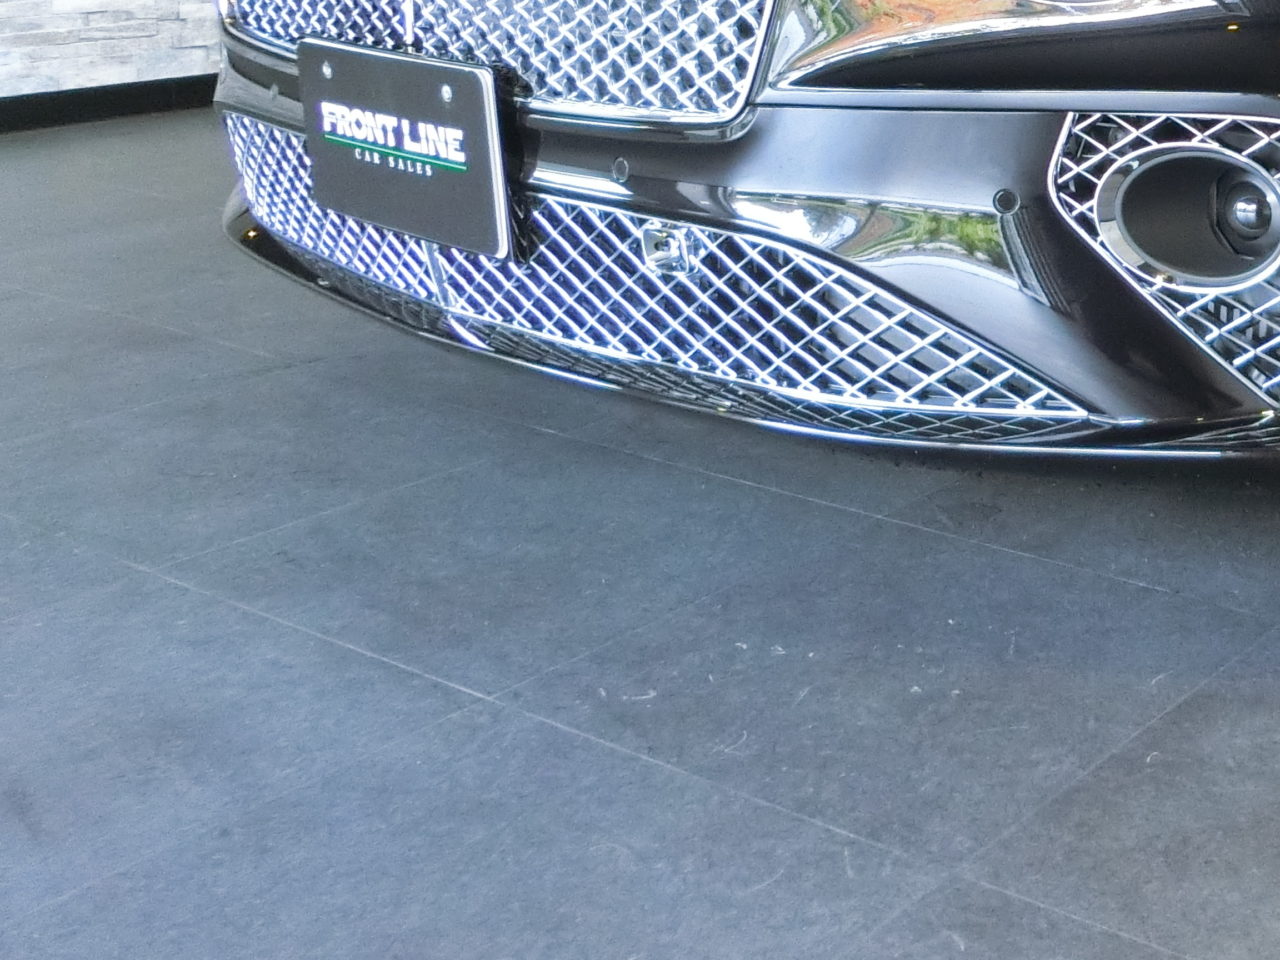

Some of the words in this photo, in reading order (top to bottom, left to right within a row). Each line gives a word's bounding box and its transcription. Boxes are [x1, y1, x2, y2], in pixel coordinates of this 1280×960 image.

[321, 101, 398, 146] FRONT
[402, 119, 466, 163] LINE
[355, 148, 380, 165] CAR
[389, 156, 432, 177] SALES
